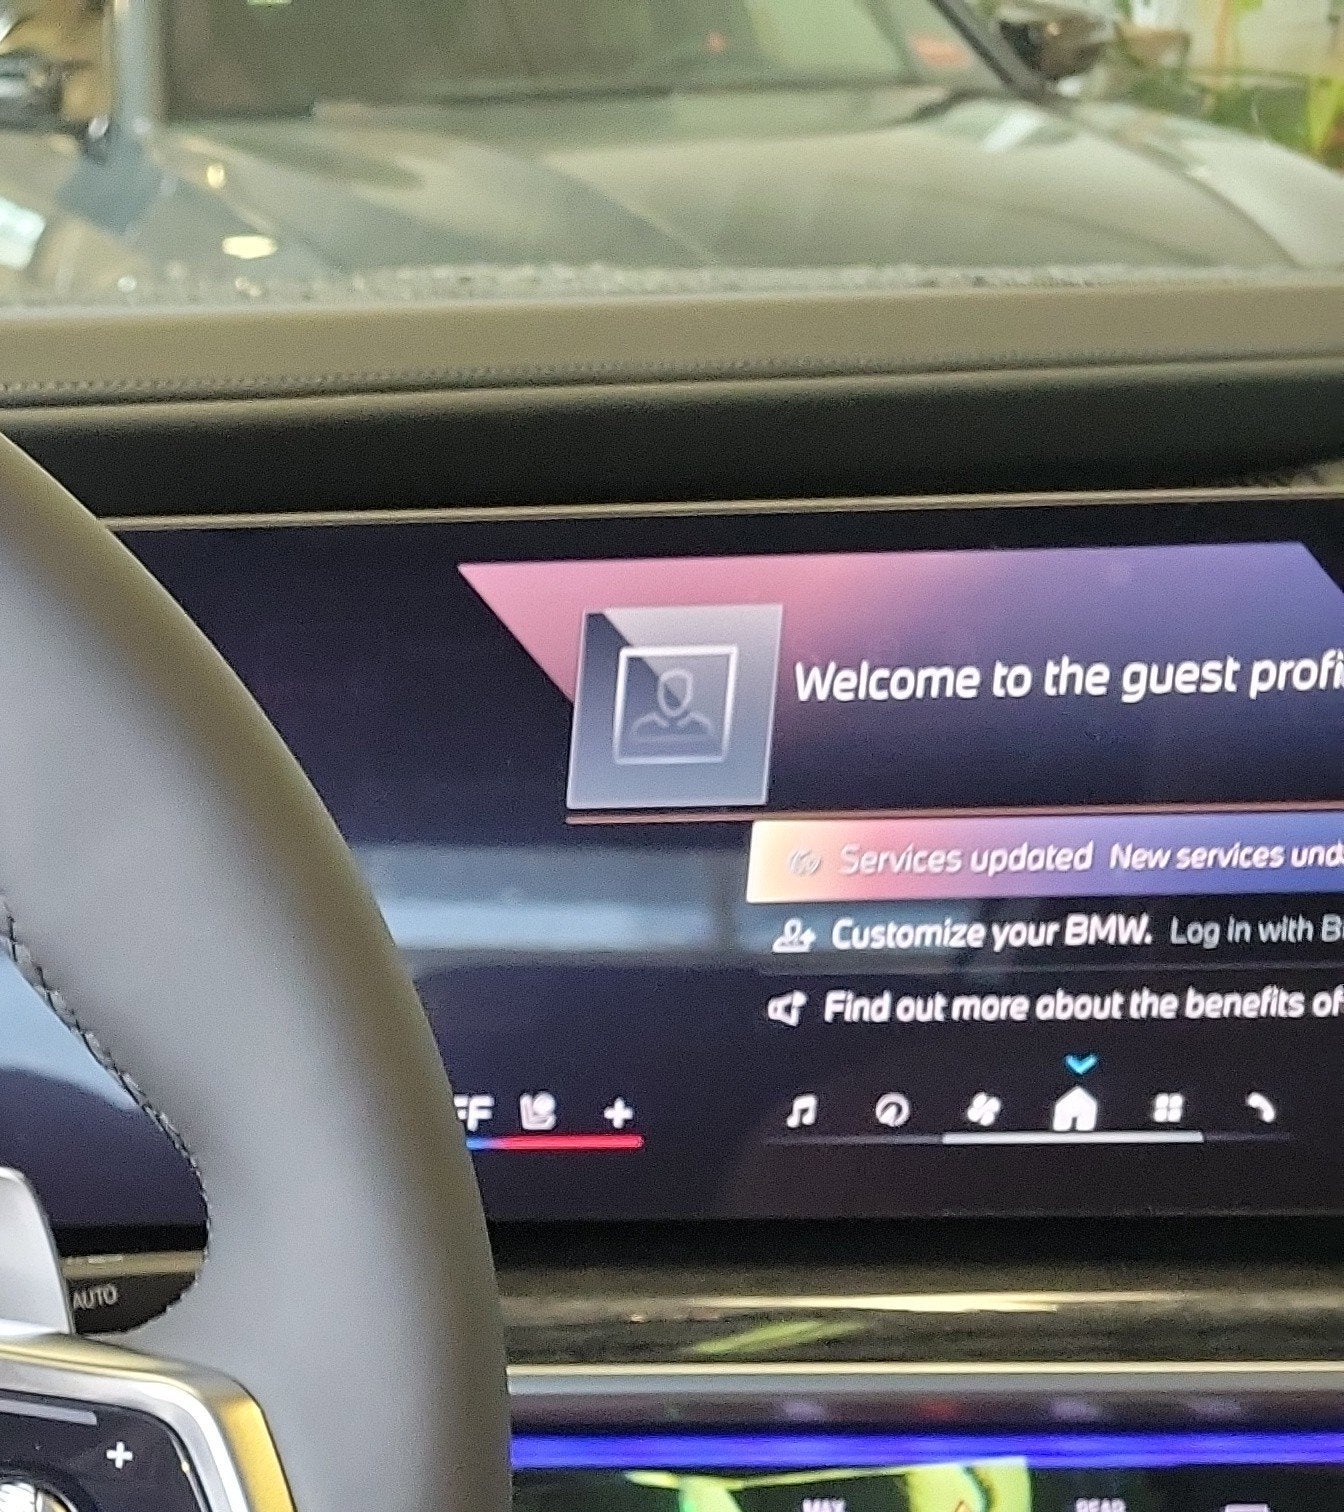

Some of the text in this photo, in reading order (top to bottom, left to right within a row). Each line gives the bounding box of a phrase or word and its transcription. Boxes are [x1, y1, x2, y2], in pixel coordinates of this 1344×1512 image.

[794, 648, 1344, 704] Welcome to the guest profi
[838, 837, 1344, 878] Services updated New services und
[831, 911, 1344, 954] Customize your BMW. Log in with B
[823, 982, 1344, 1023] Find out more about the benefits of
[71, 1283, 119, 1311] AUTO
